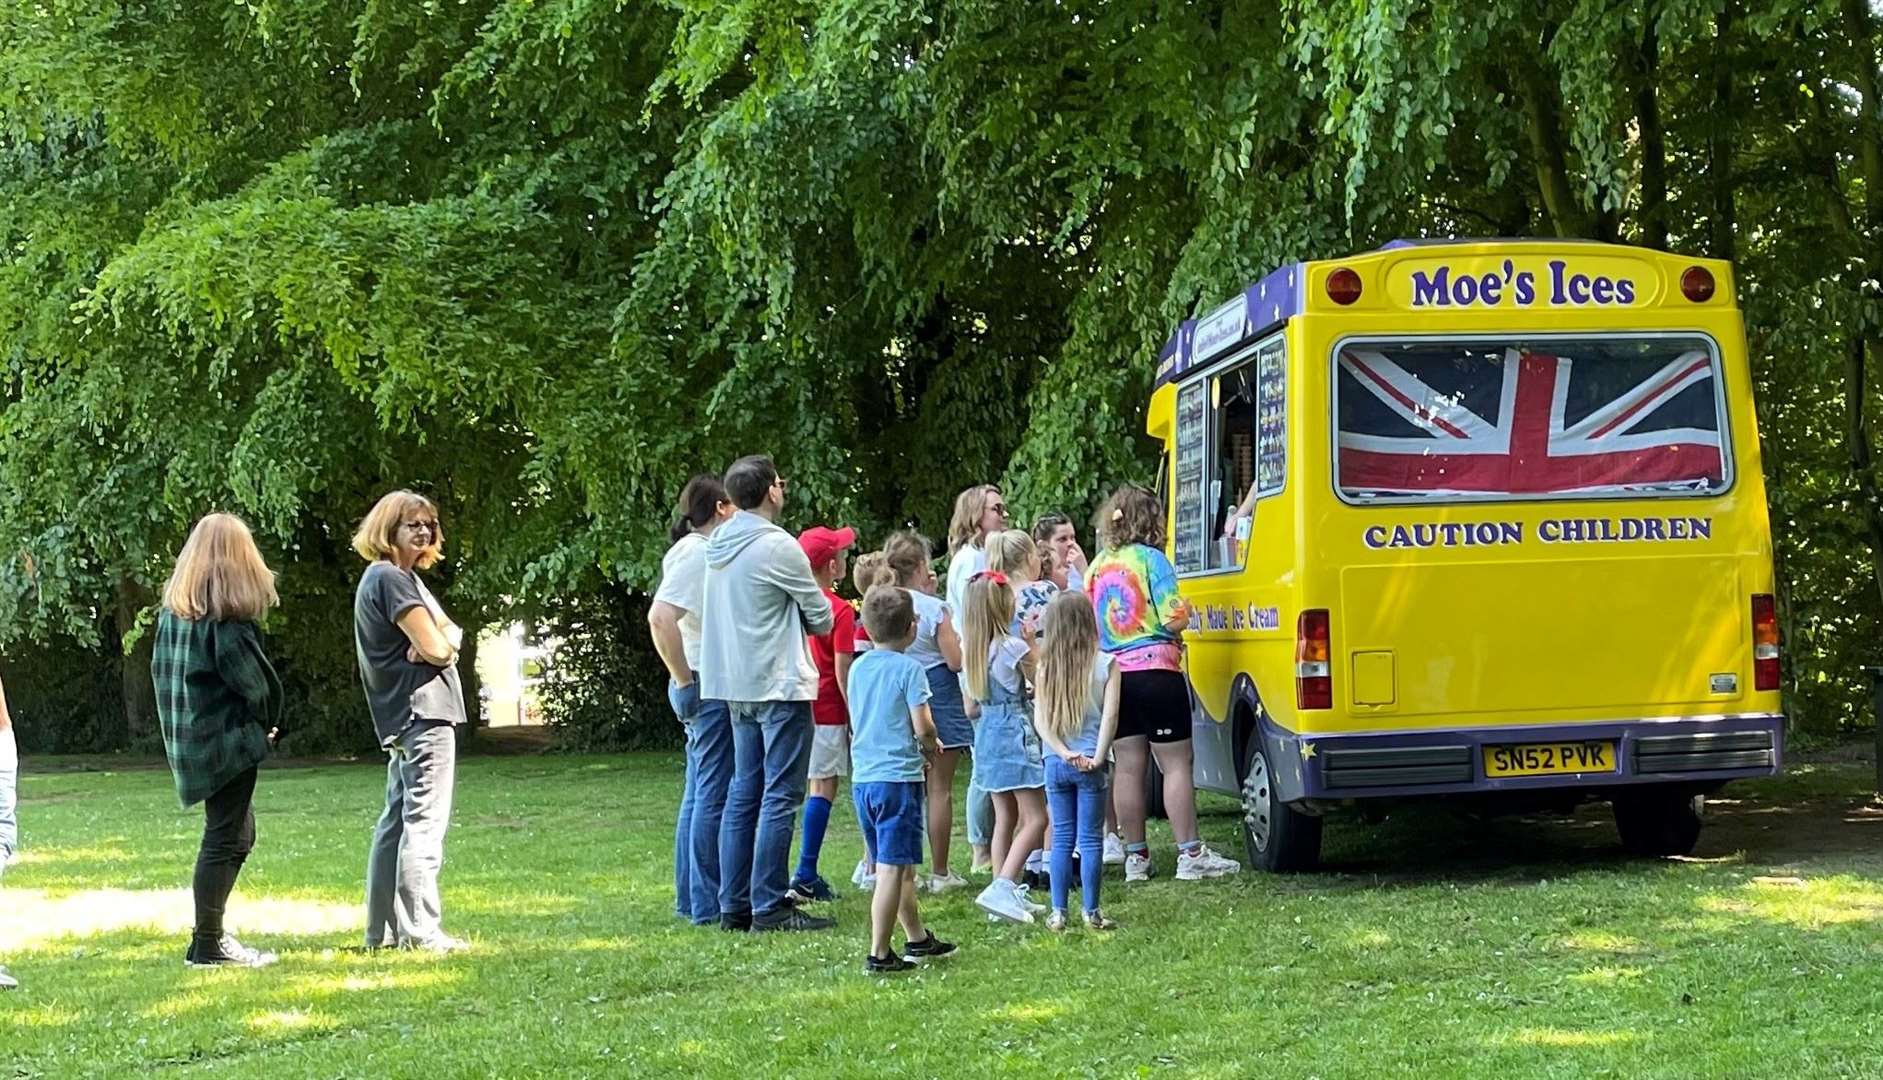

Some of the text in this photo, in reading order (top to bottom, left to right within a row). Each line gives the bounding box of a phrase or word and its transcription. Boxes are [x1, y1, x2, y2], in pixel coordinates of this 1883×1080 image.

[1411, 259, 1636, 307] Moe's Ices
[1364, 516, 1713, 549] CAUTION CHILDREN
[1231, 604, 1244, 631] Ice
[1247, 600, 1280, 631] Cream
[1494, 745, 1606, 771] SN52 PVK
